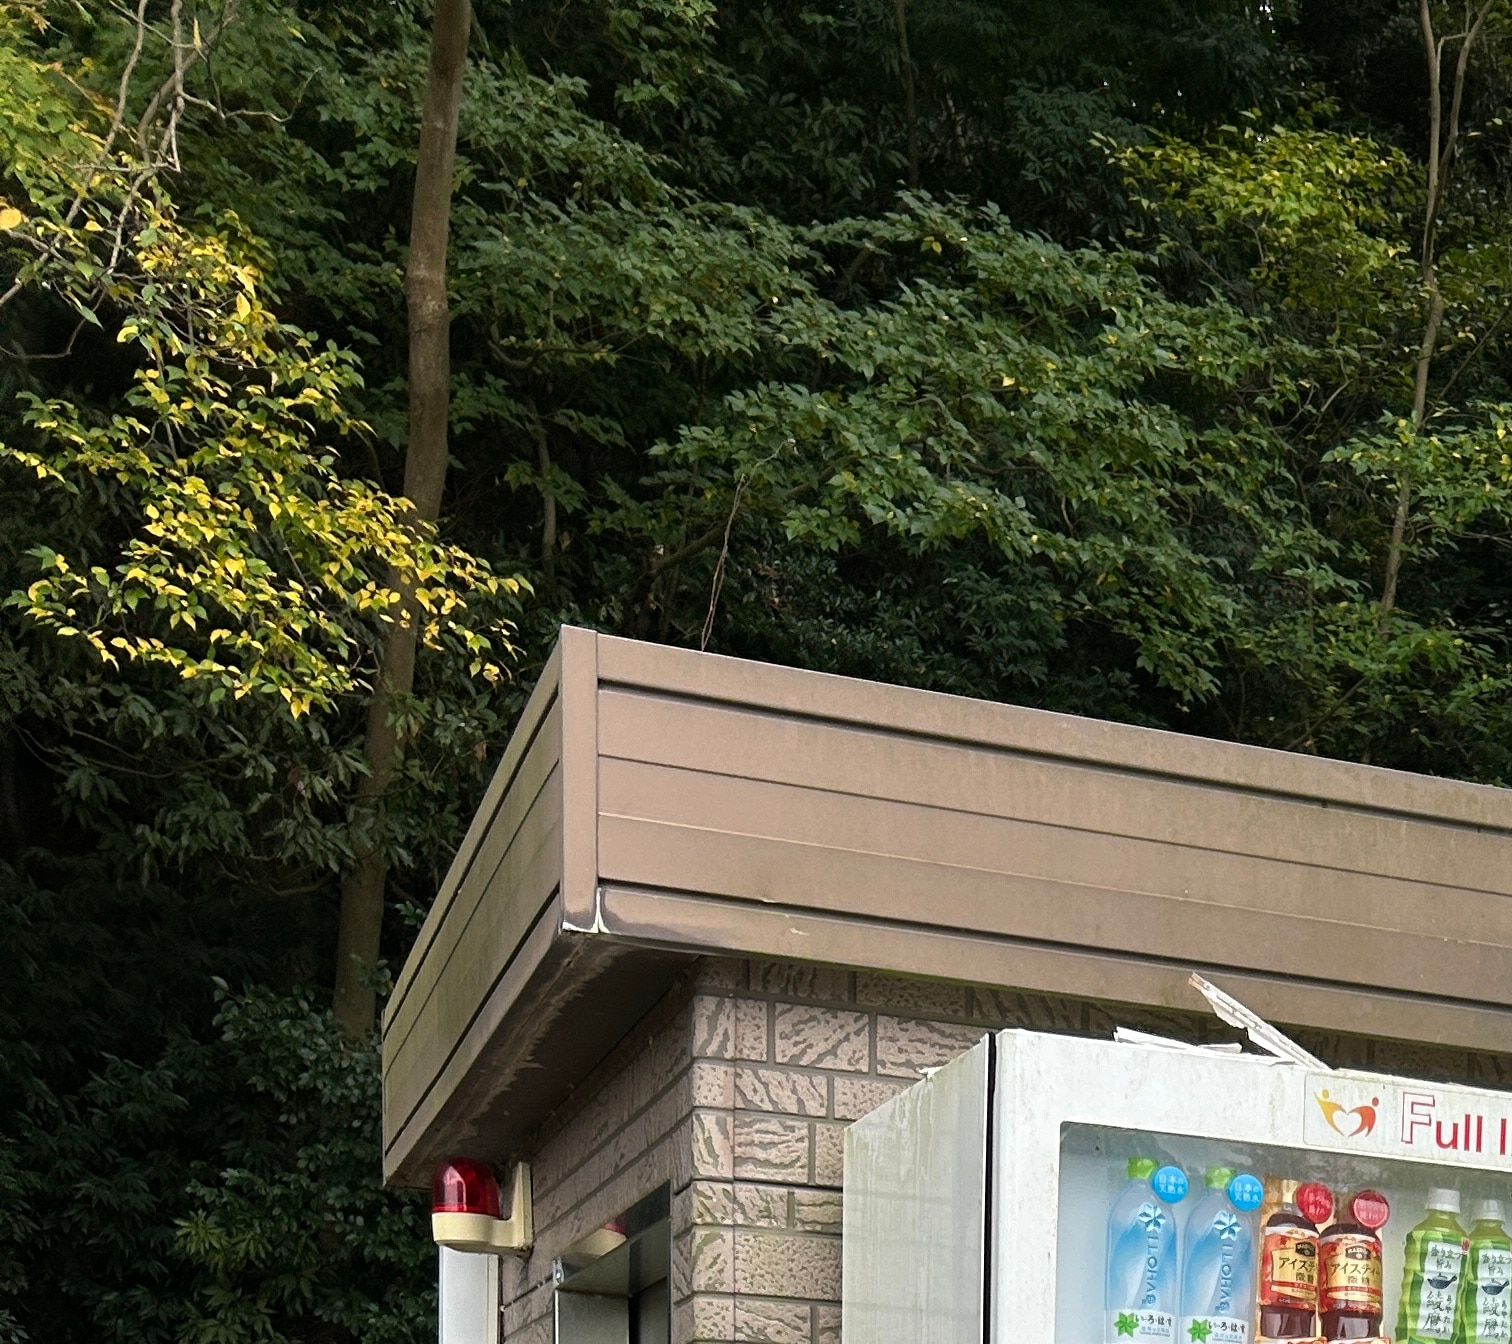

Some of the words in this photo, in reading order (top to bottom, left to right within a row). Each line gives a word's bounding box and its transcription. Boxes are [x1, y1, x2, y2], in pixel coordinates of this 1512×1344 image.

[1401, 1091, 1482, 1153] Full
[1159, 1185, 1185, 1196] 天然水
